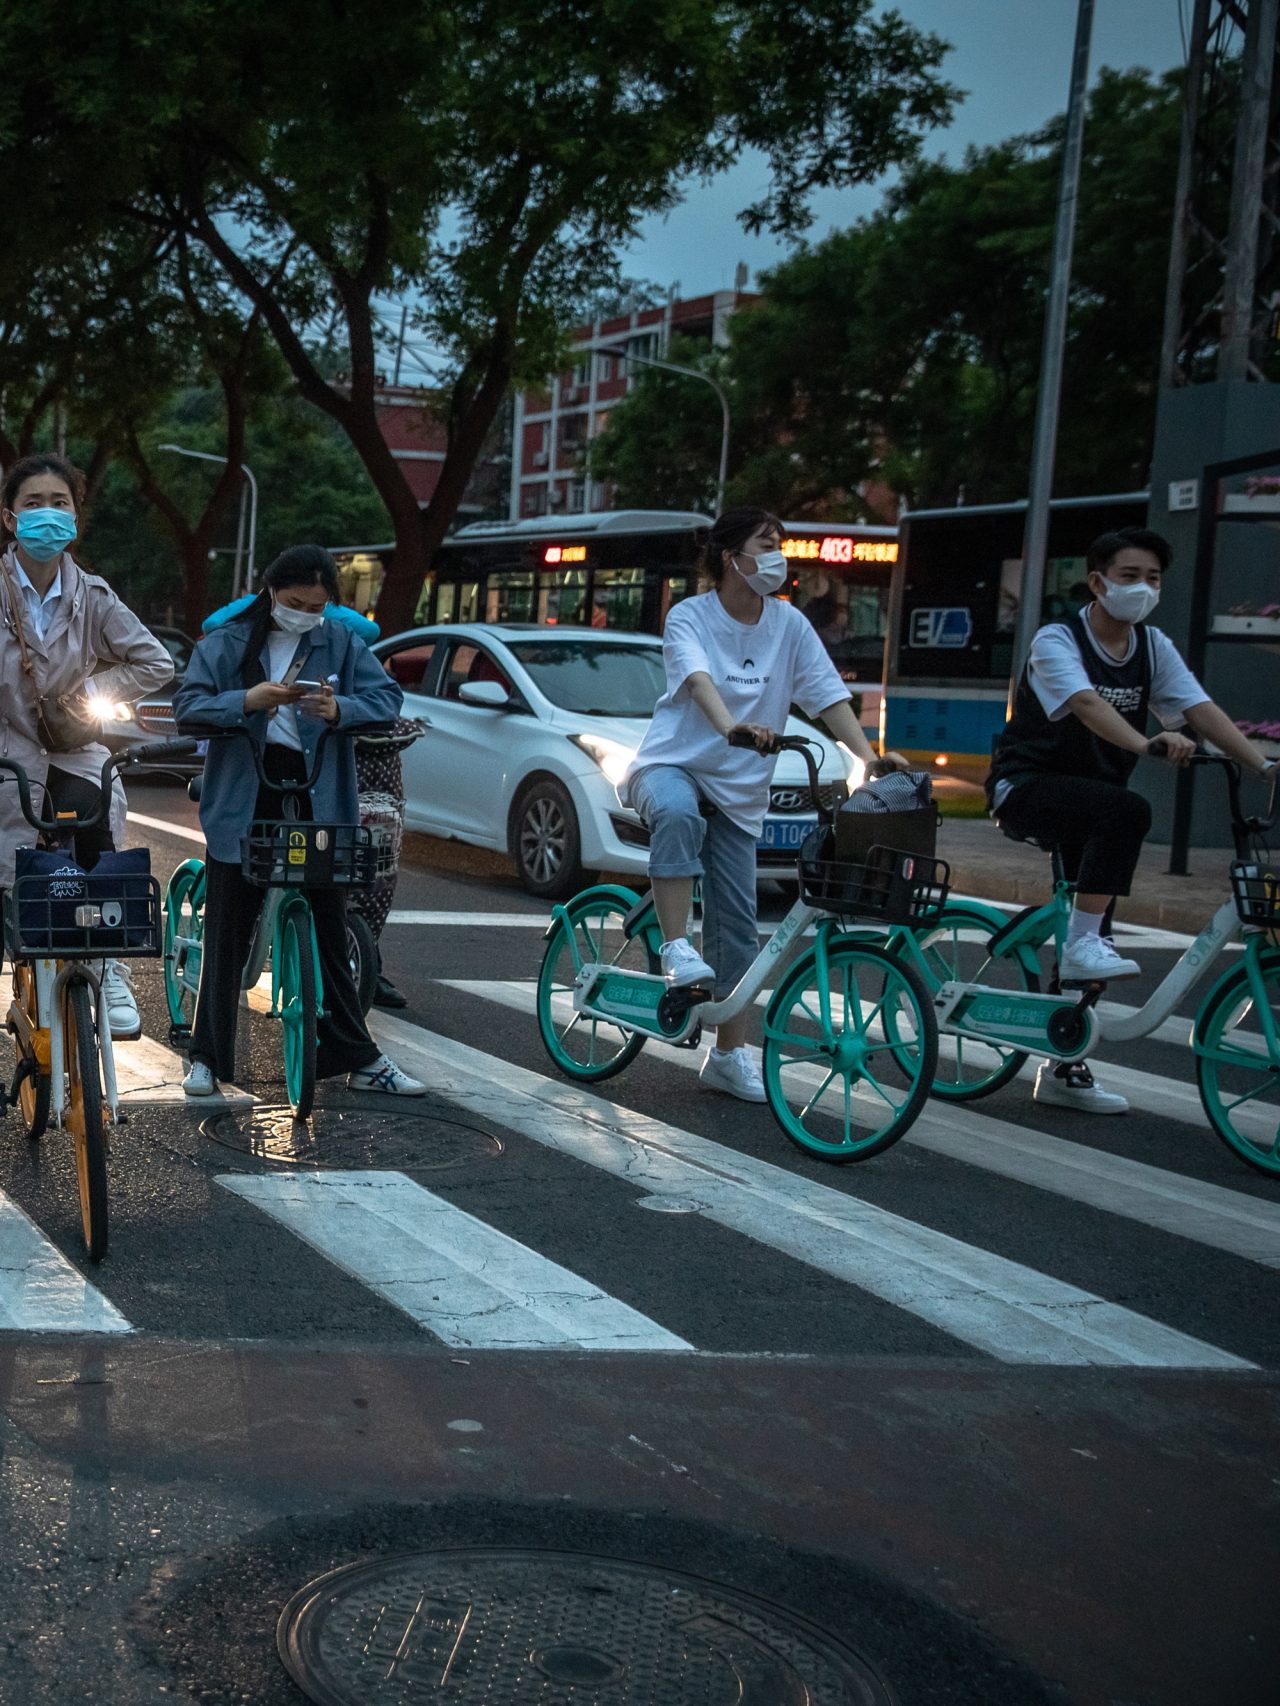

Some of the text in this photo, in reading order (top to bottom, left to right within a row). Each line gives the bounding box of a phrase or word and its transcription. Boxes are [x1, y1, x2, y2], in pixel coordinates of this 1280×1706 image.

[819, 538, 853, 562] 403
[725, 675, 761, 685] ANOTHER
[780, 824, 816, 845] T06
